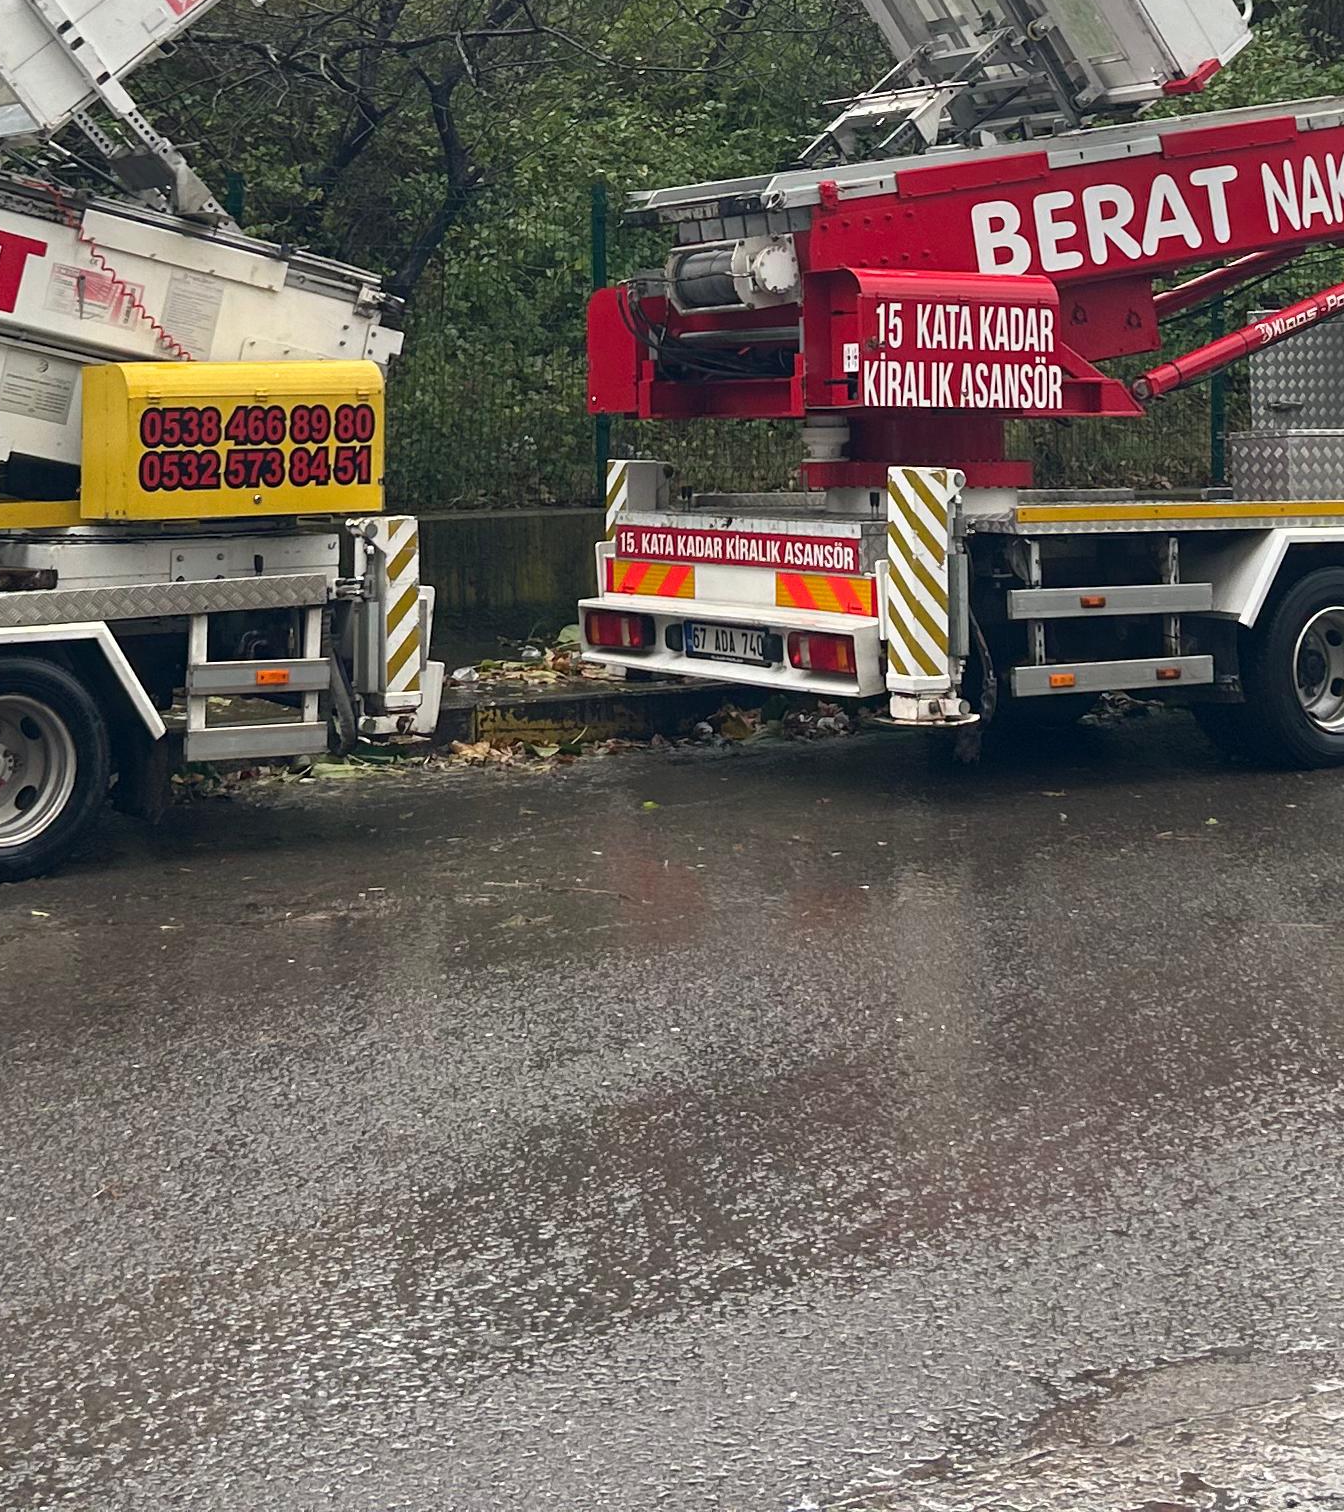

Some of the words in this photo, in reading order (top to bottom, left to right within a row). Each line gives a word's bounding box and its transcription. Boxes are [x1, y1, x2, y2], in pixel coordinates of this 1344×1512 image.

[970, 165, 1239, 276] BERAT
[875, 302, 904, 349] 15
[916, 303, 974, 350] KATA
[979, 305, 1055, 353] KADAR
[863, 352, 954, 407] KİRALIK
[960, 356, 1063, 409] ASANSÖR
[140, 407, 222, 448] 0538
[225, 405, 287, 446] 466
[290, 404, 331, 445] 89
[334, 404, 375, 444] 80
[139, 449, 221, 492] 0532
[224, 448, 285, 488] 573
[289, 447, 331, 487] 84
[334, 445, 373, 485] 51
[620, 532, 639, 554] 15.
[642, 533, 674, 556] KATA
[677, 535, 722, 559] KADAR
[726, 535, 781, 563] KİRALIK
[784, 542, 854, 571] ASANSÖR
[693, 627, 706, 649] 67
[715, 629, 735, 653] ADA
[741, 632, 764, 656] 740
